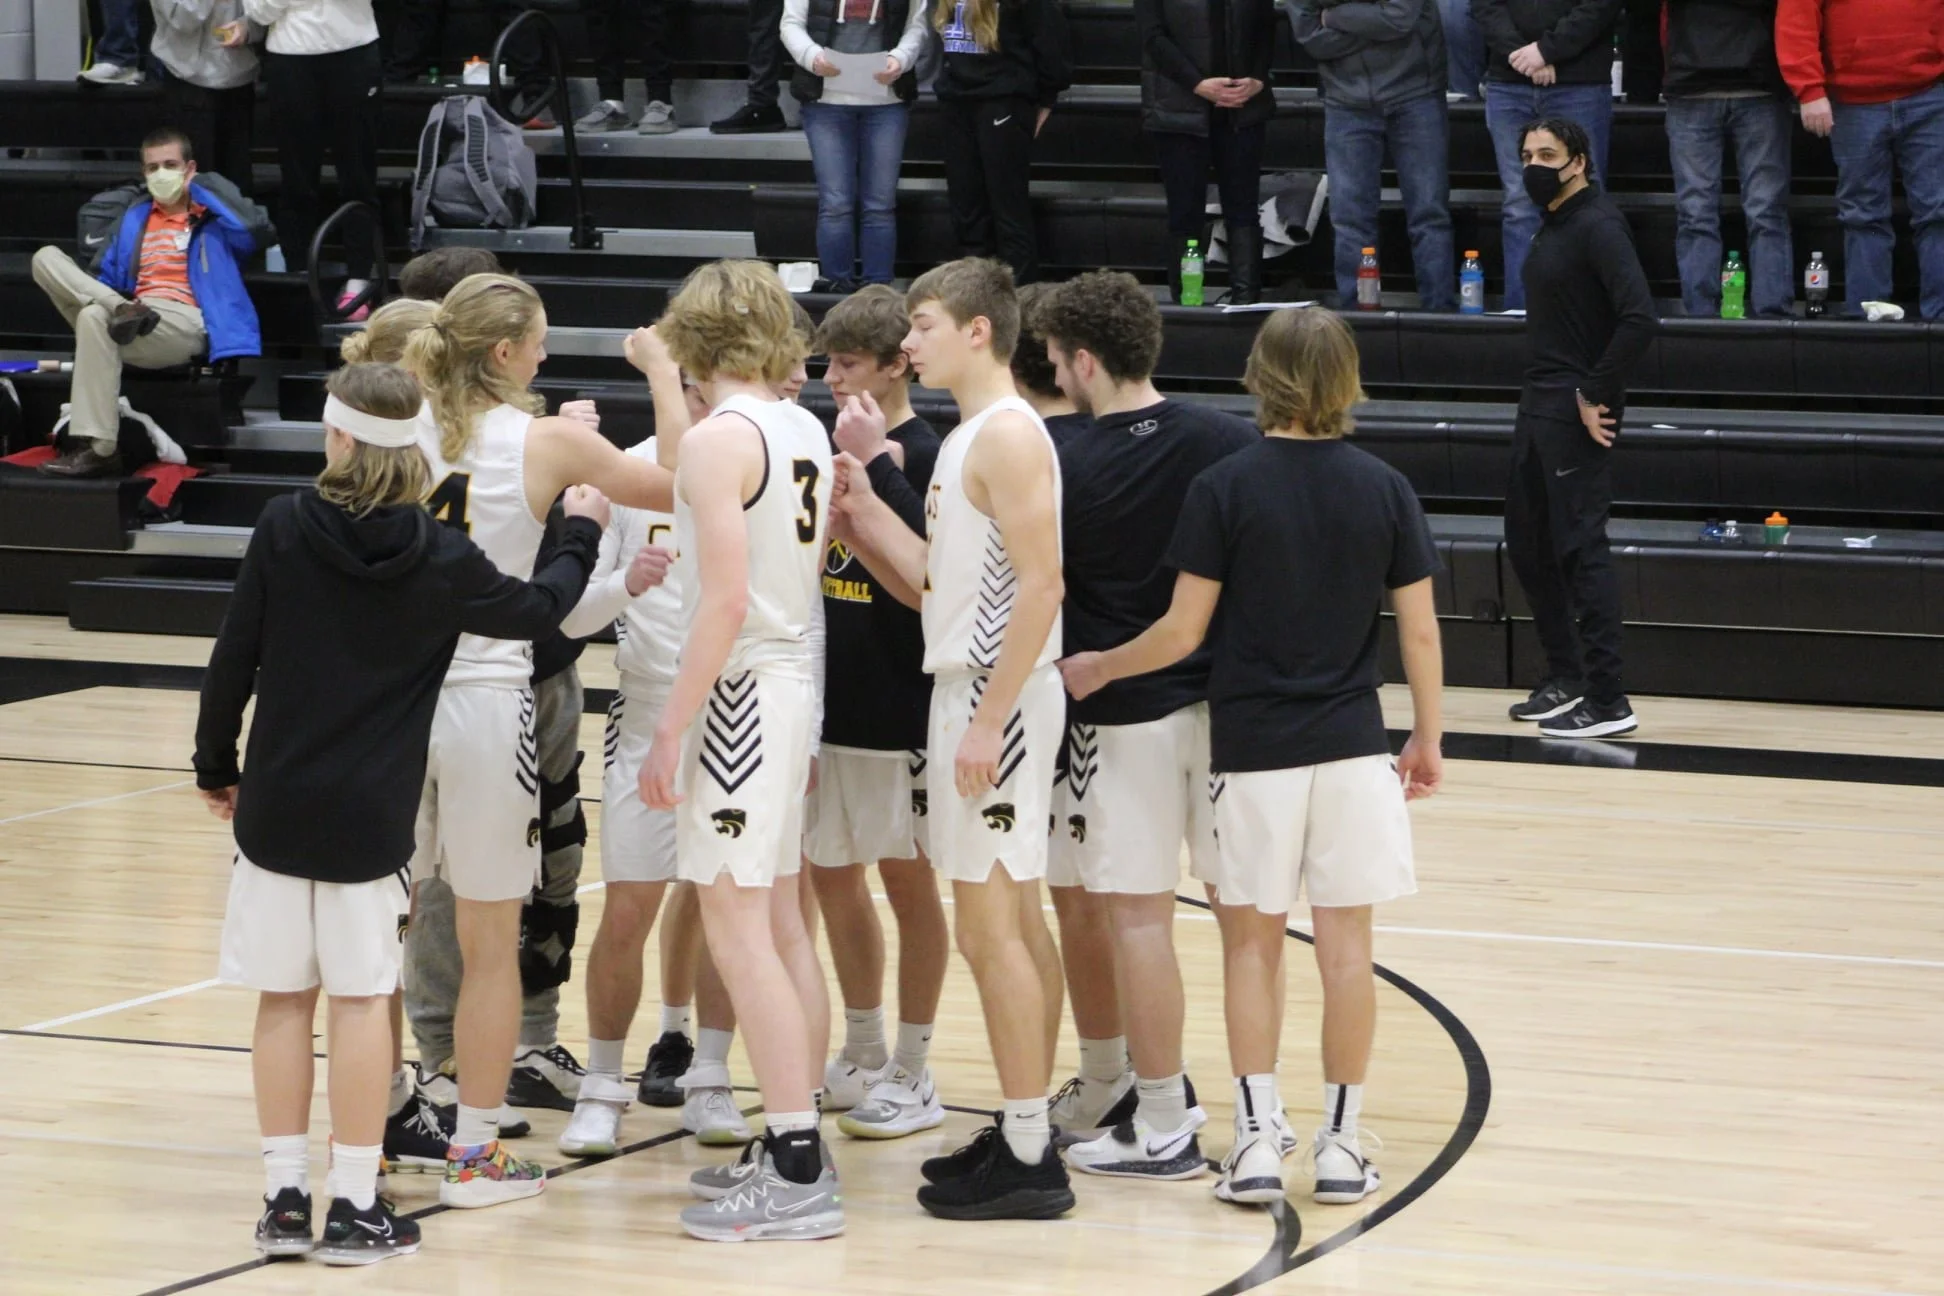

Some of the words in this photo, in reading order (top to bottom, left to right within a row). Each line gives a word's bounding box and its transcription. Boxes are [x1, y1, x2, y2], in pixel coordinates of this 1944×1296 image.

[1461, 283, 1472, 297] G
[424, 471, 472, 536] 4
[792, 457, 820, 544] 3
